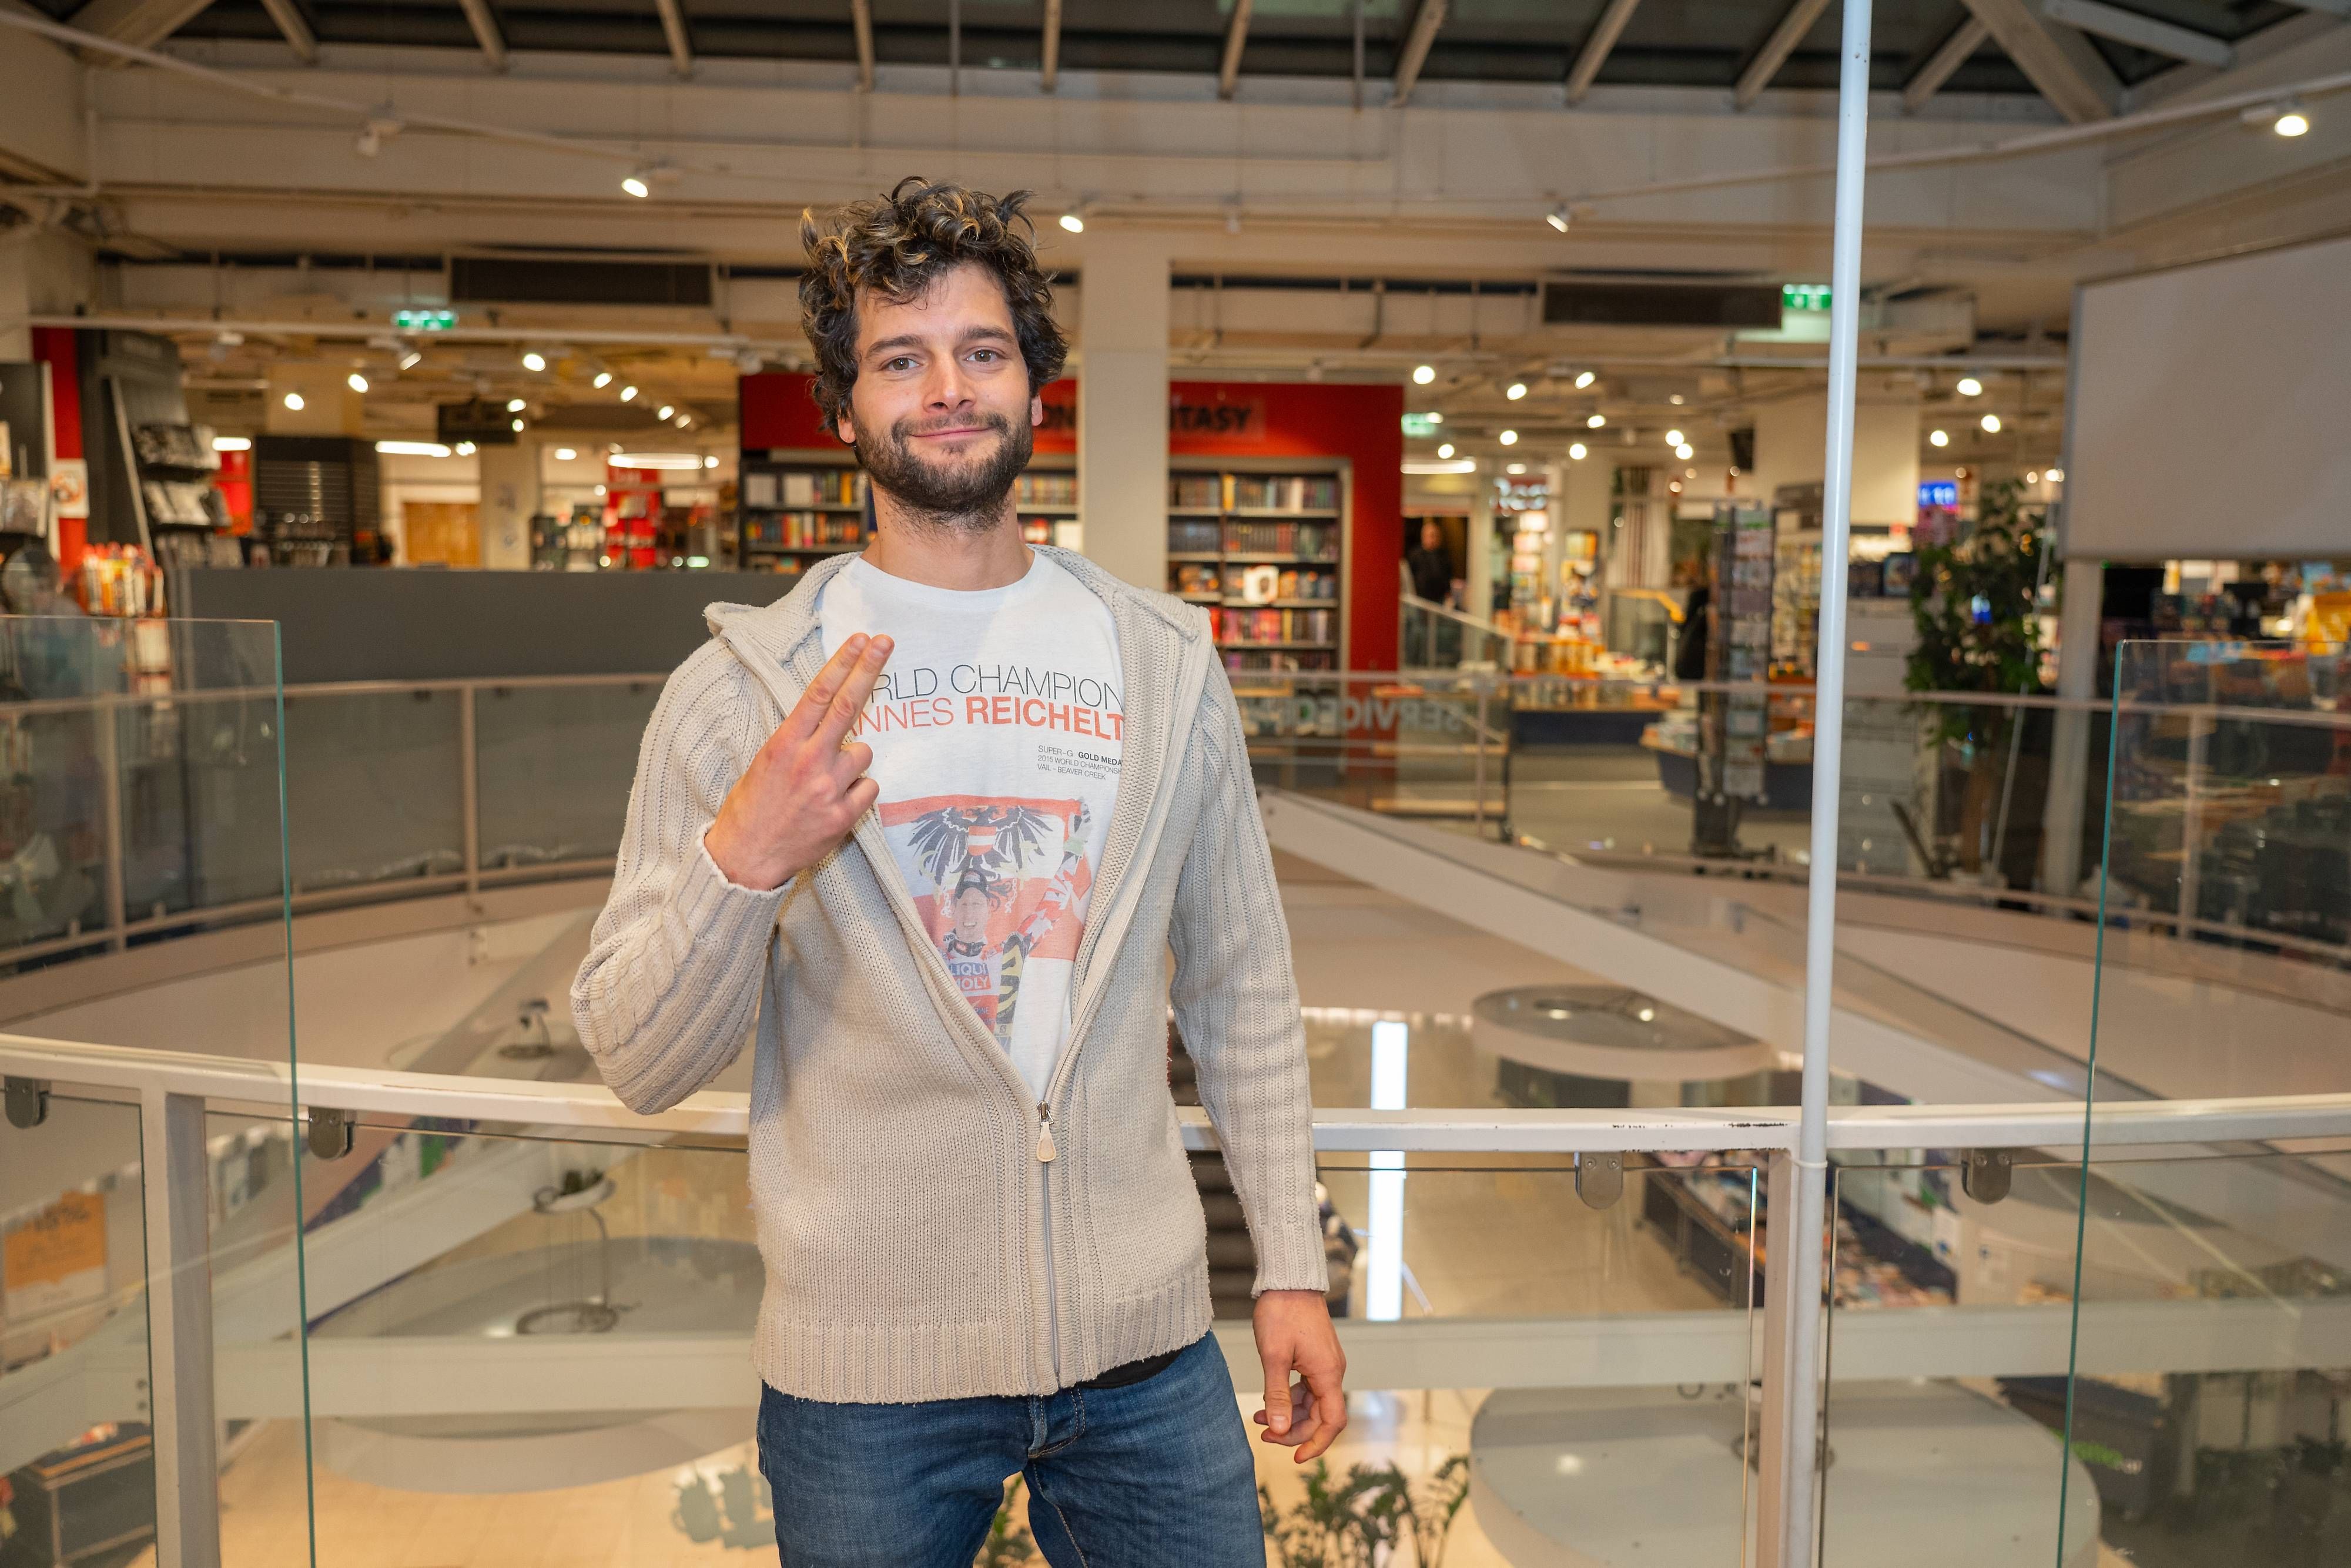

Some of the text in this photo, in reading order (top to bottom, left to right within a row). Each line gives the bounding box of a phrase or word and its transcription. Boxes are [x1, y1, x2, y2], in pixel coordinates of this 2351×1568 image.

[1170, 404, 1253, 432] TASY
[871, 664, 1123, 712] RLD CHAMPION
[852, 696, 1124, 741] NNES REICHELT
[1037, 755, 1122, 775] 2015 WORLD CHAMPIONSH
[1038, 745, 1122, 766] SUPER-G GOLD MEDA
[1057, 766, 1083, 776] BEAVER
[1084, 770, 1106, 780] CREEK
